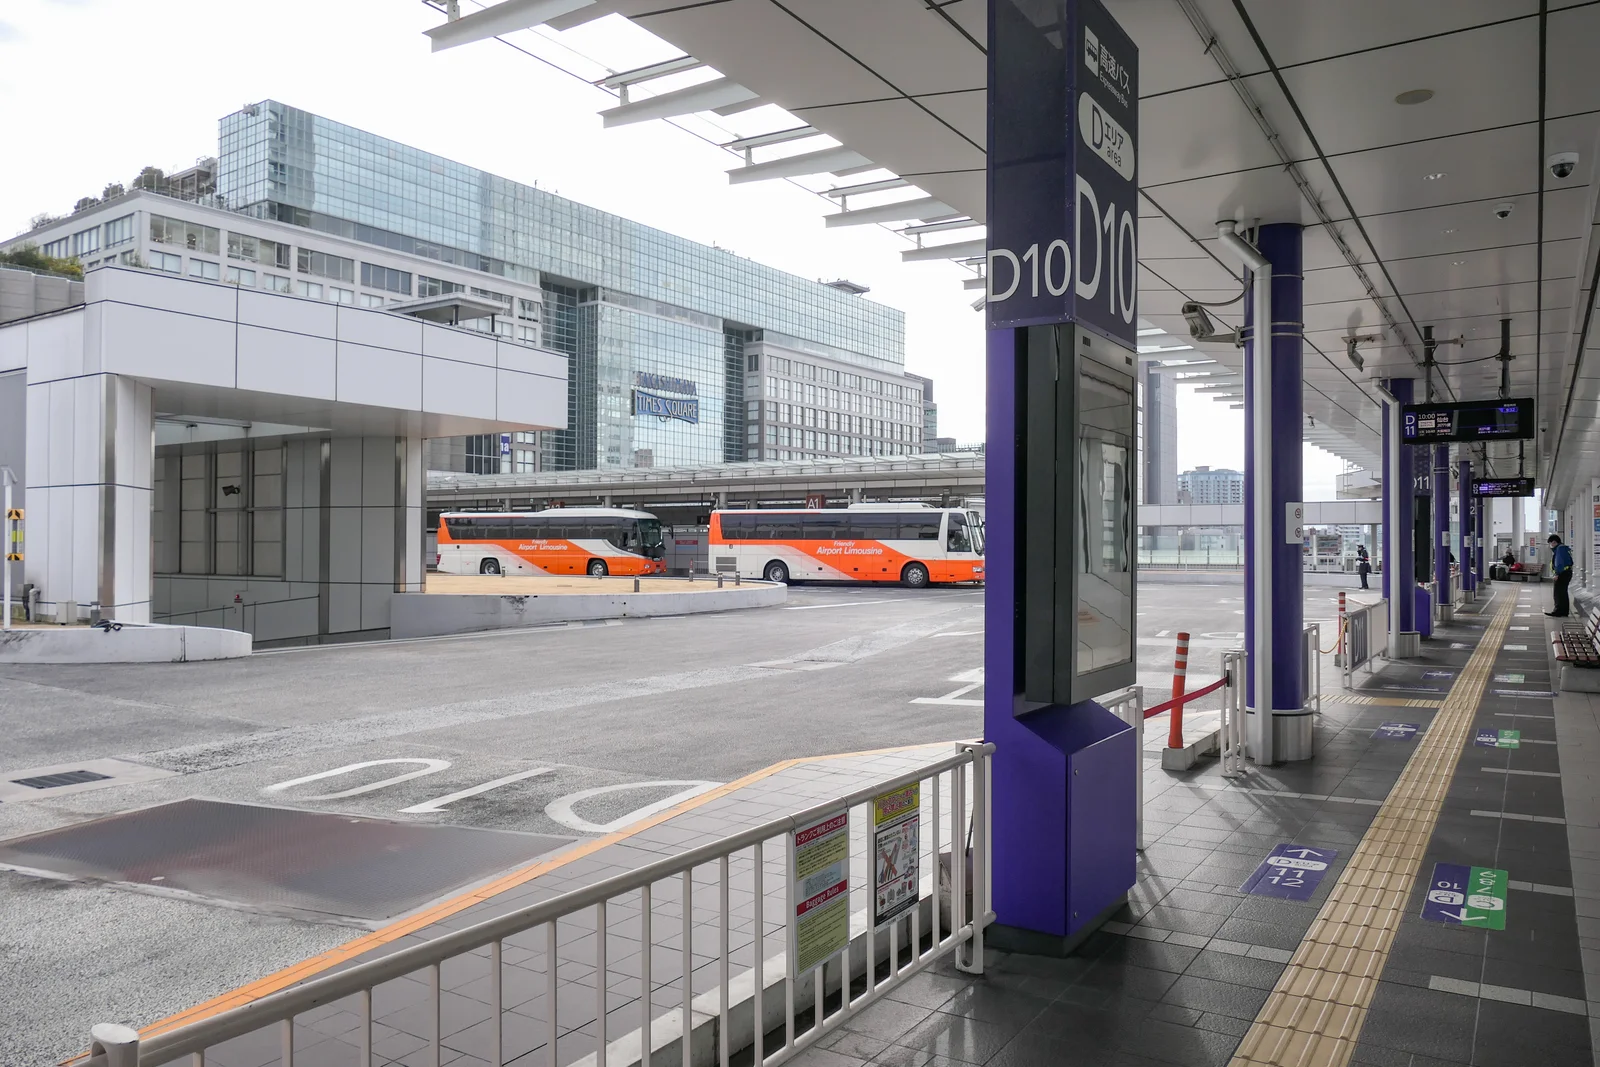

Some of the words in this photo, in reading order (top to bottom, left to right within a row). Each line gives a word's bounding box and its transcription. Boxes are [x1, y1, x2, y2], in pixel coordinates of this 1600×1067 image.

[1099, 44, 1130, 95] 高速バス
[1092, 103, 1104, 150] D
[1105, 121, 1124, 151] エリア
[1106, 145, 1122, 168] area
[1075, 173, 1137, 325] D10
[986, 239, 1072, 303] D10
[638, 395, 662, 413] TIMES
[660, 399, 698, 422] SQUARE
[1405, 415, 1416, 425] D
[1405, 425, 1416, 436] 11
[807, 498, 819, 509] A1
[518, 543, 537, 551] Airport
[816, 546, 842, 556] Airport
[844, 546, 883, 555] Limousine
[1275, 867, 1305, 878] 11
[1268, 876, 1305, 888] 12
[805, 892, 827, 909] Baggage
[826, 886, 839, 899] Rules
